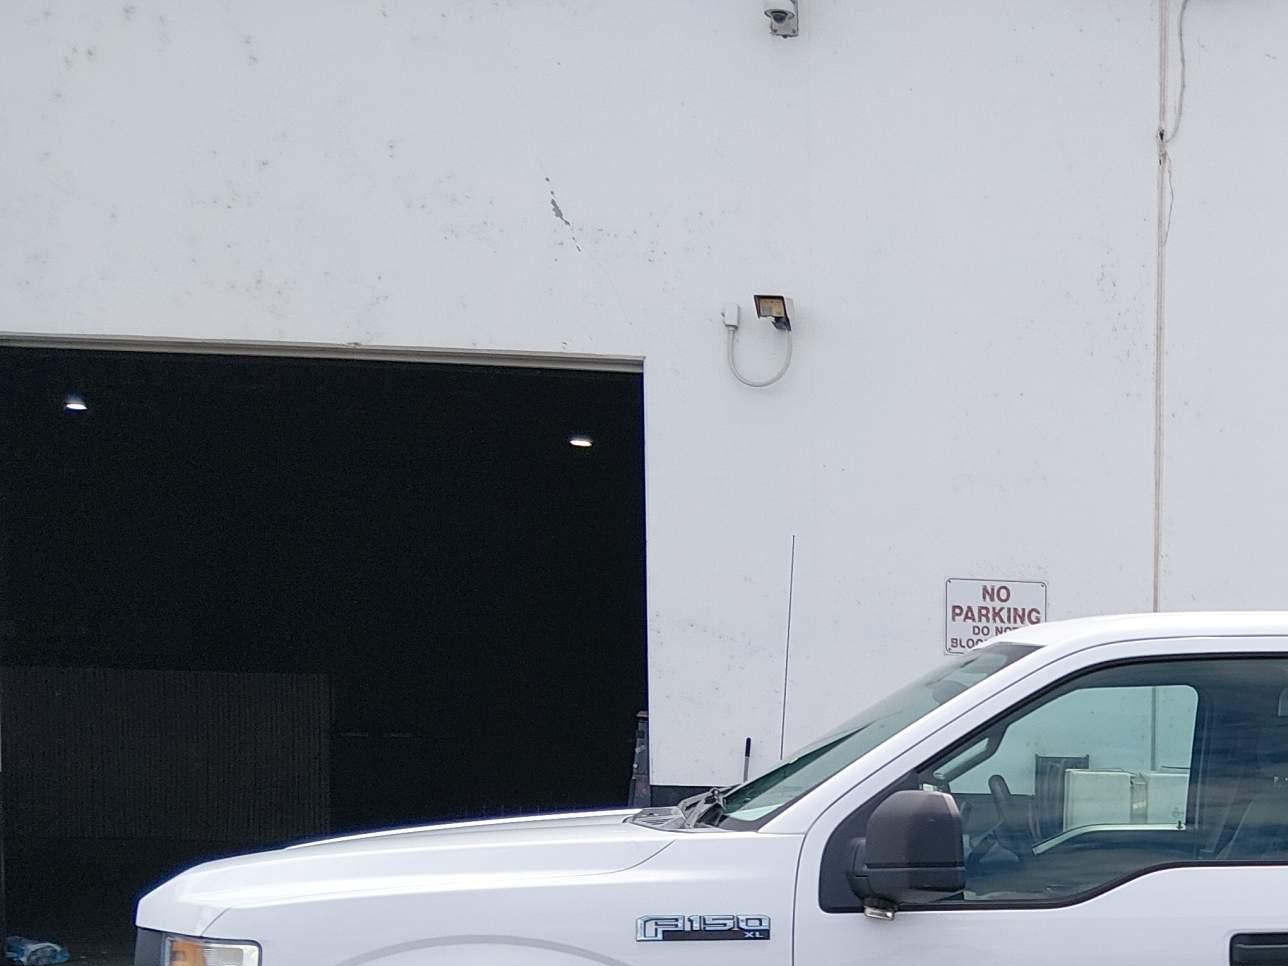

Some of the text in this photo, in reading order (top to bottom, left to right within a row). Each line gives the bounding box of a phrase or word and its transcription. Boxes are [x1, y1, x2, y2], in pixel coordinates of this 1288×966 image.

[982, 585, 1011, 603] NO
[951, 605, 1041, 625] PARKING
[972, 625, 990, 637] DO
[950, 637, 988, 649] BLOC
[743, 930, 765, 939] XL
